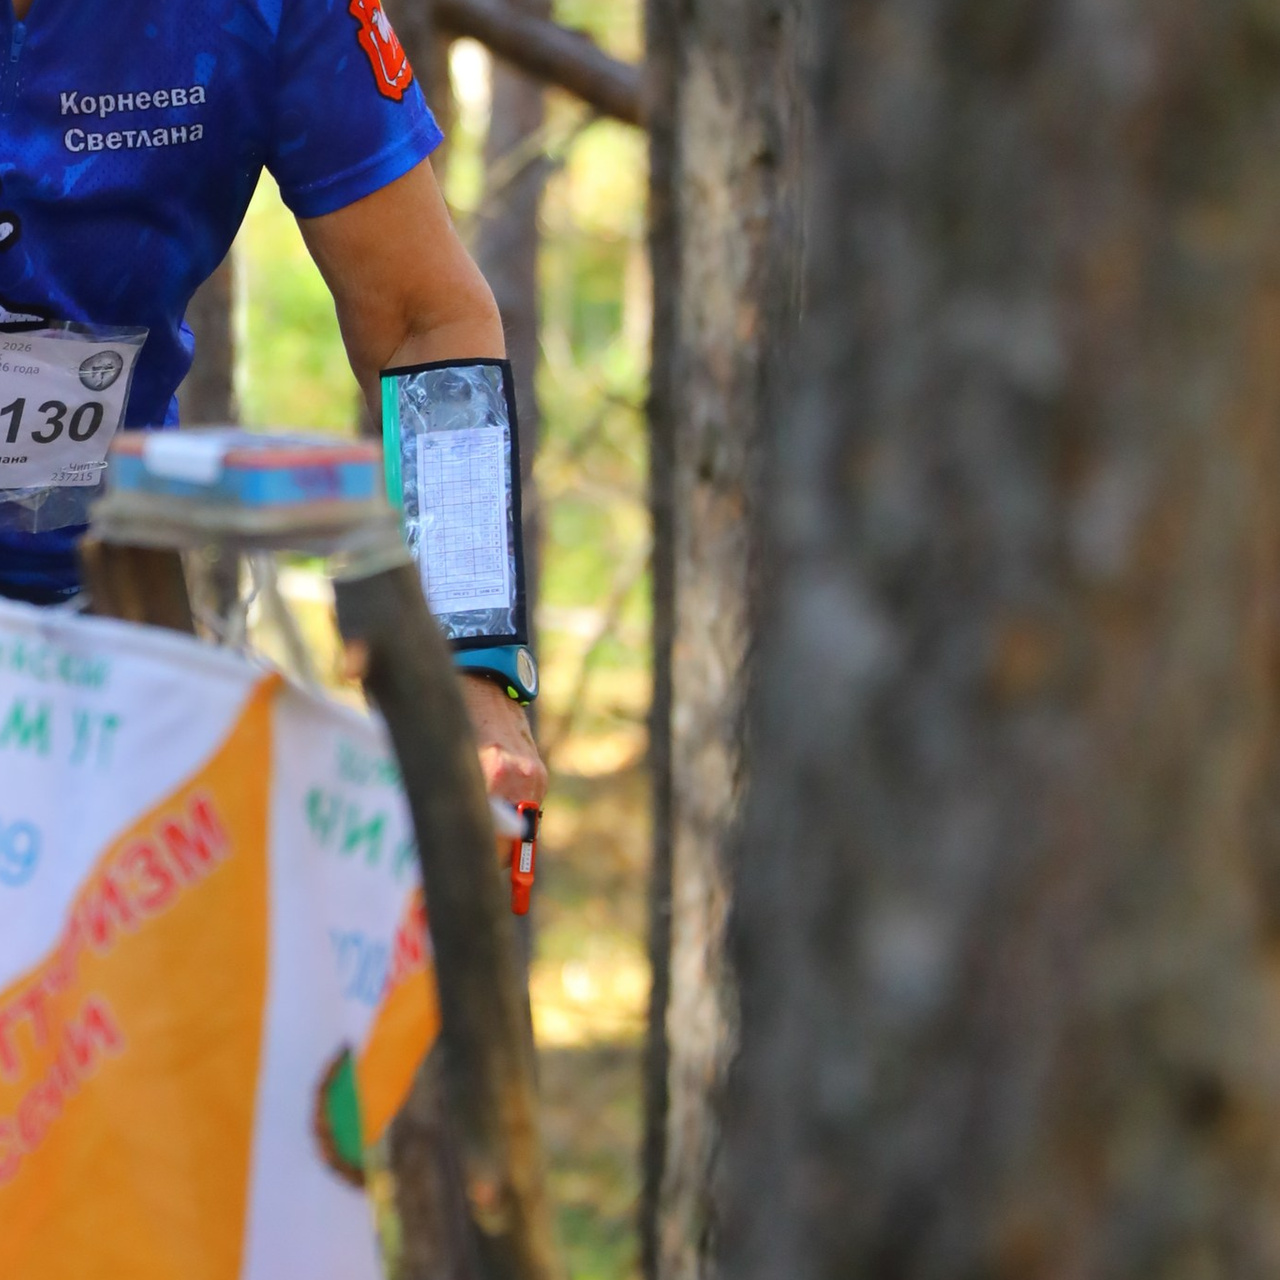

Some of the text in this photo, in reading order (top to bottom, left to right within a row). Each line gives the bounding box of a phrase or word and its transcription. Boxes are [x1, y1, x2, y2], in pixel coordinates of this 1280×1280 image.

[59, 85, 207, 118] Корнеева
[64, 123, 204, 152] Светлана
[2, 341, 32, 353] 2026
[12, 365, 41, 376] года
[0, 397, 104, 444] 130
